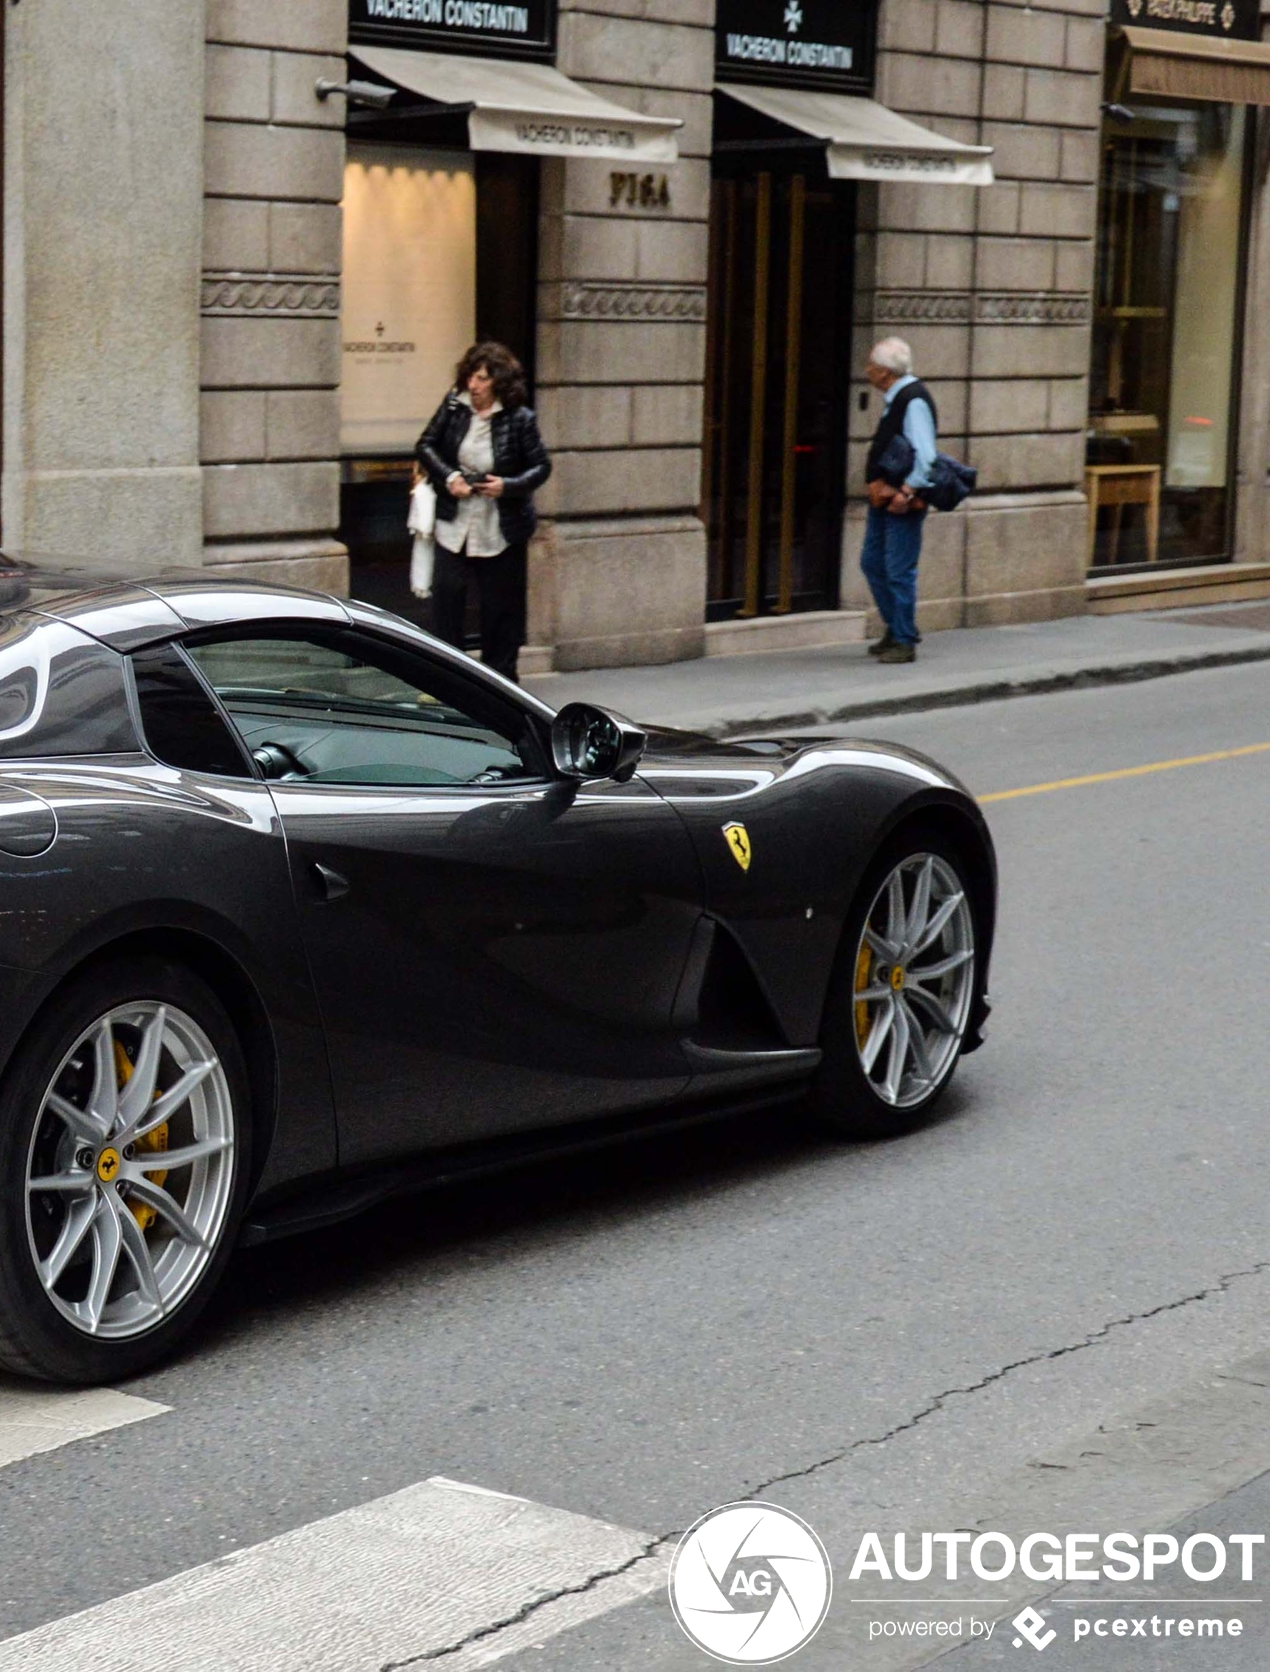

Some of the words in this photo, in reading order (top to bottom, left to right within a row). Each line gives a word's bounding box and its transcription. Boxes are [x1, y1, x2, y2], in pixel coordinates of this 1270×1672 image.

[366, 0, 442, 23] VACHERON
[444, 0, 528, 33] CONSTANTIN
[726, 33, 785, 62] VACHERON
[787, 41, 852, 69] CONSTANTIN
[516, 123, 571, 144] VACHERON
[574, 127, 635, 149] CONSTANTIN
